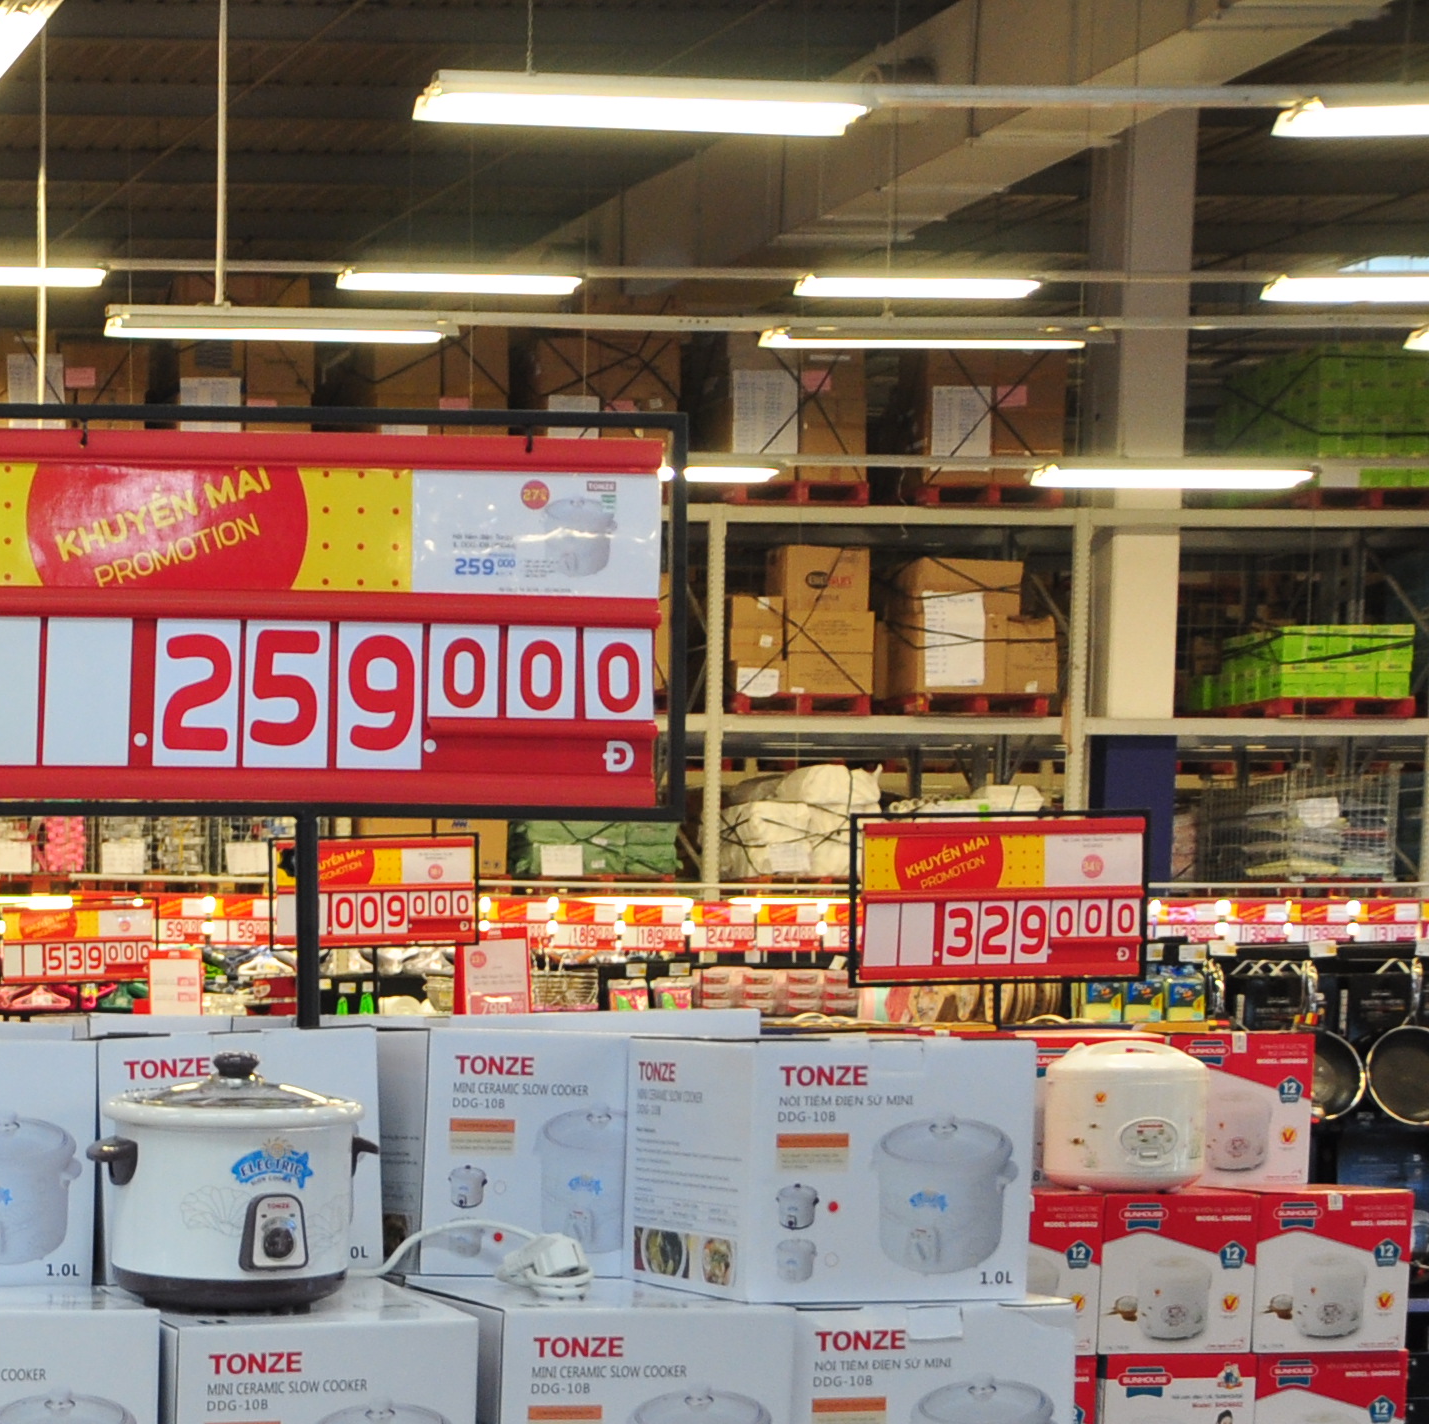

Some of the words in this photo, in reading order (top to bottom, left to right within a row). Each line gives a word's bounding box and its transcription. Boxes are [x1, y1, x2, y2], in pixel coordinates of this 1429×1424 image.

[55, 483, 199, 562] KHUYẾN
[93, 512, 261, 588] PROMOTION
[454, 558, 495, 576] 259
[919, 854, 986, 890] PROMOTION
[123, 1056, 212, 1081] TONZE
[454, 1054, 535, 1077] TONZE
[638, 1061, 677, 1083] TONZE
[779, 1065, 869, 1087] TONZE
[452, 1081, 476, 1095] MINI
[477, 1082, 520, 1096] CERAMIC
[521, 1083, 549, 1096] SLOW
[551, 1084, 589, 1097] COOKER
[1282, 1082, 1297, 1094] 12
[452, 1096, 506, 1110] DDG-10B
[886, 1094, 914, 1107] MINI
[777, 1111, 837, 1123] DDG-10B
[238, 1154, 305, 1179] ELECTRIC
[1071, 1246, 1087, 1260] 12
[1225, 1247, 1240, 1260] 12
[1379, 1245, 1396, 1258] 12
[45, 1262, 81, 1278] 1.0L
[979, 1270, 1014, 1286] 1.0L
[533, 1335, 625, 1358] TONZE
[815, 1329, 906, 1352] TONZE
[208, 1351, 303, 1376] TONZE
[924, 1357, 952, 1369] MINI
[0, 1367, 47, 1382] COOKER
[531, 1365, 558, 1379] MINI
[559, 1365, 607, 1379] CERAMIC
[609, 1365, 641, 1378] SLOW
[643, 1364, 688, 1379] COOKER
[206, 1382, 234, 1396] MINI
[236, 1380, 286, 1396] CERAMIC
[288, 1379, 320, 1394] SLOW
[322, 1378, 368, 1393] COOKER
[530, 1382, 591, 1395] DDG-10B
[812, 1375, 874, 1388] DDG-10B
[206, 1398, 269, 1413] DDG-10B
[1374, 1401, 1389, 1415] 12
